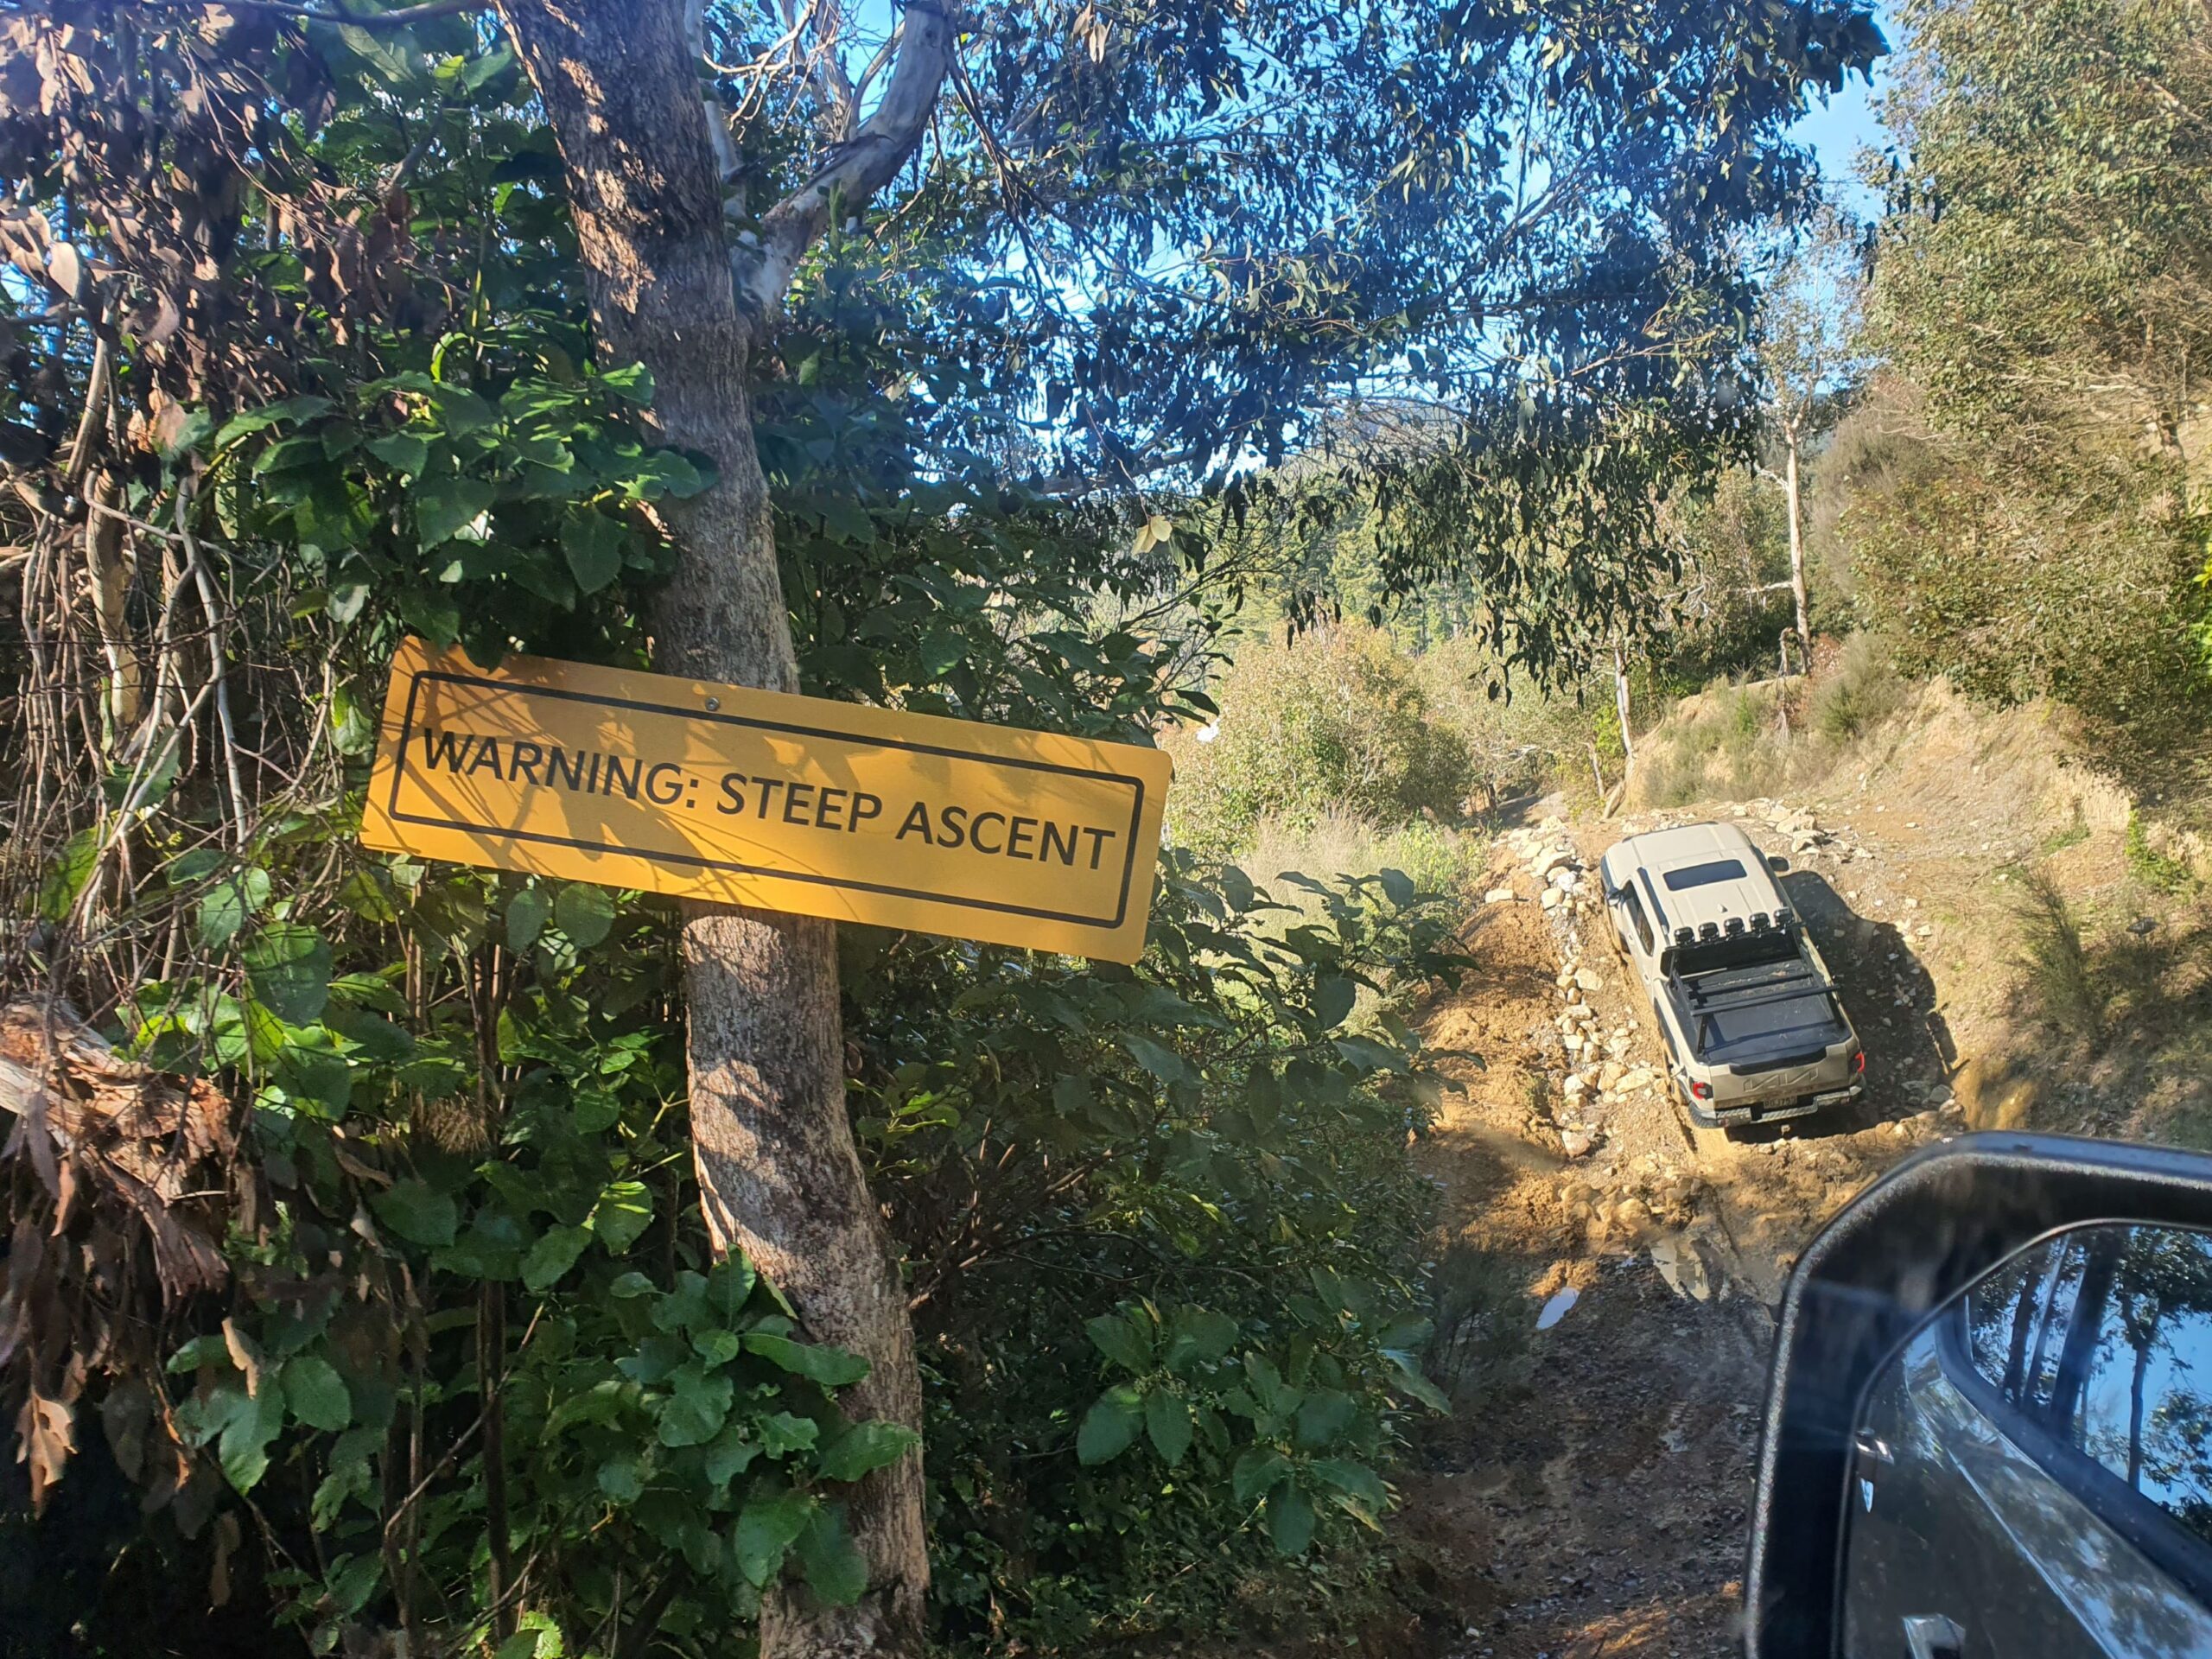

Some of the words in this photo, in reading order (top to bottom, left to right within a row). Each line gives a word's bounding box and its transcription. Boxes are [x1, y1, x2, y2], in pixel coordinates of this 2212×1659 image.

[423, 726, 699, 810] WARNING:
[718, 773, 882, 834] STEEP
[896, 802, 1116, 870] ASCENT
